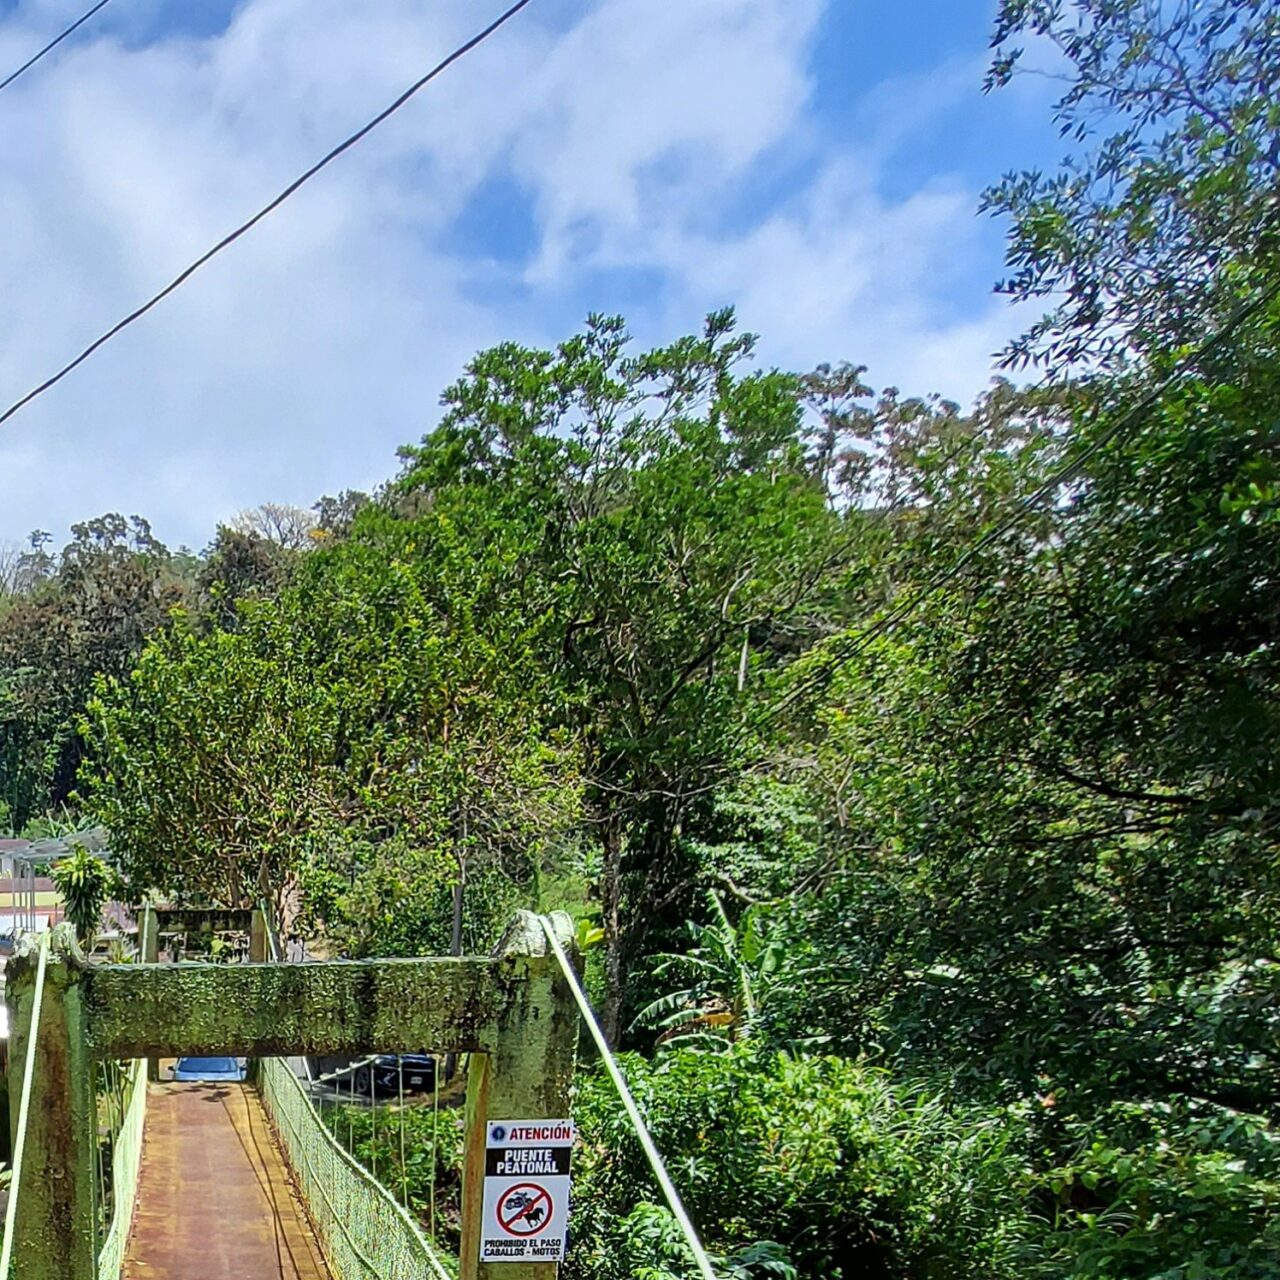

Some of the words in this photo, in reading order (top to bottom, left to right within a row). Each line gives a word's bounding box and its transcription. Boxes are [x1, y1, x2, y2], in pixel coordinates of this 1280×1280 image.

[510, 1123, 570, 1140] ATENCIÓN
[504, 1149, 552, 1162] PUENTE
[496, 1161, 559, 1174] PEATONAL
[484, 1240, 528, 1248] PROHIBIDO
[529, 1239, 539, 1247] EL
[540, 1239, 562, 1247] PASO
[484, 1248, 525, 1256] CABALLOS
[532, 1248, 560, 1256] MOTOS
